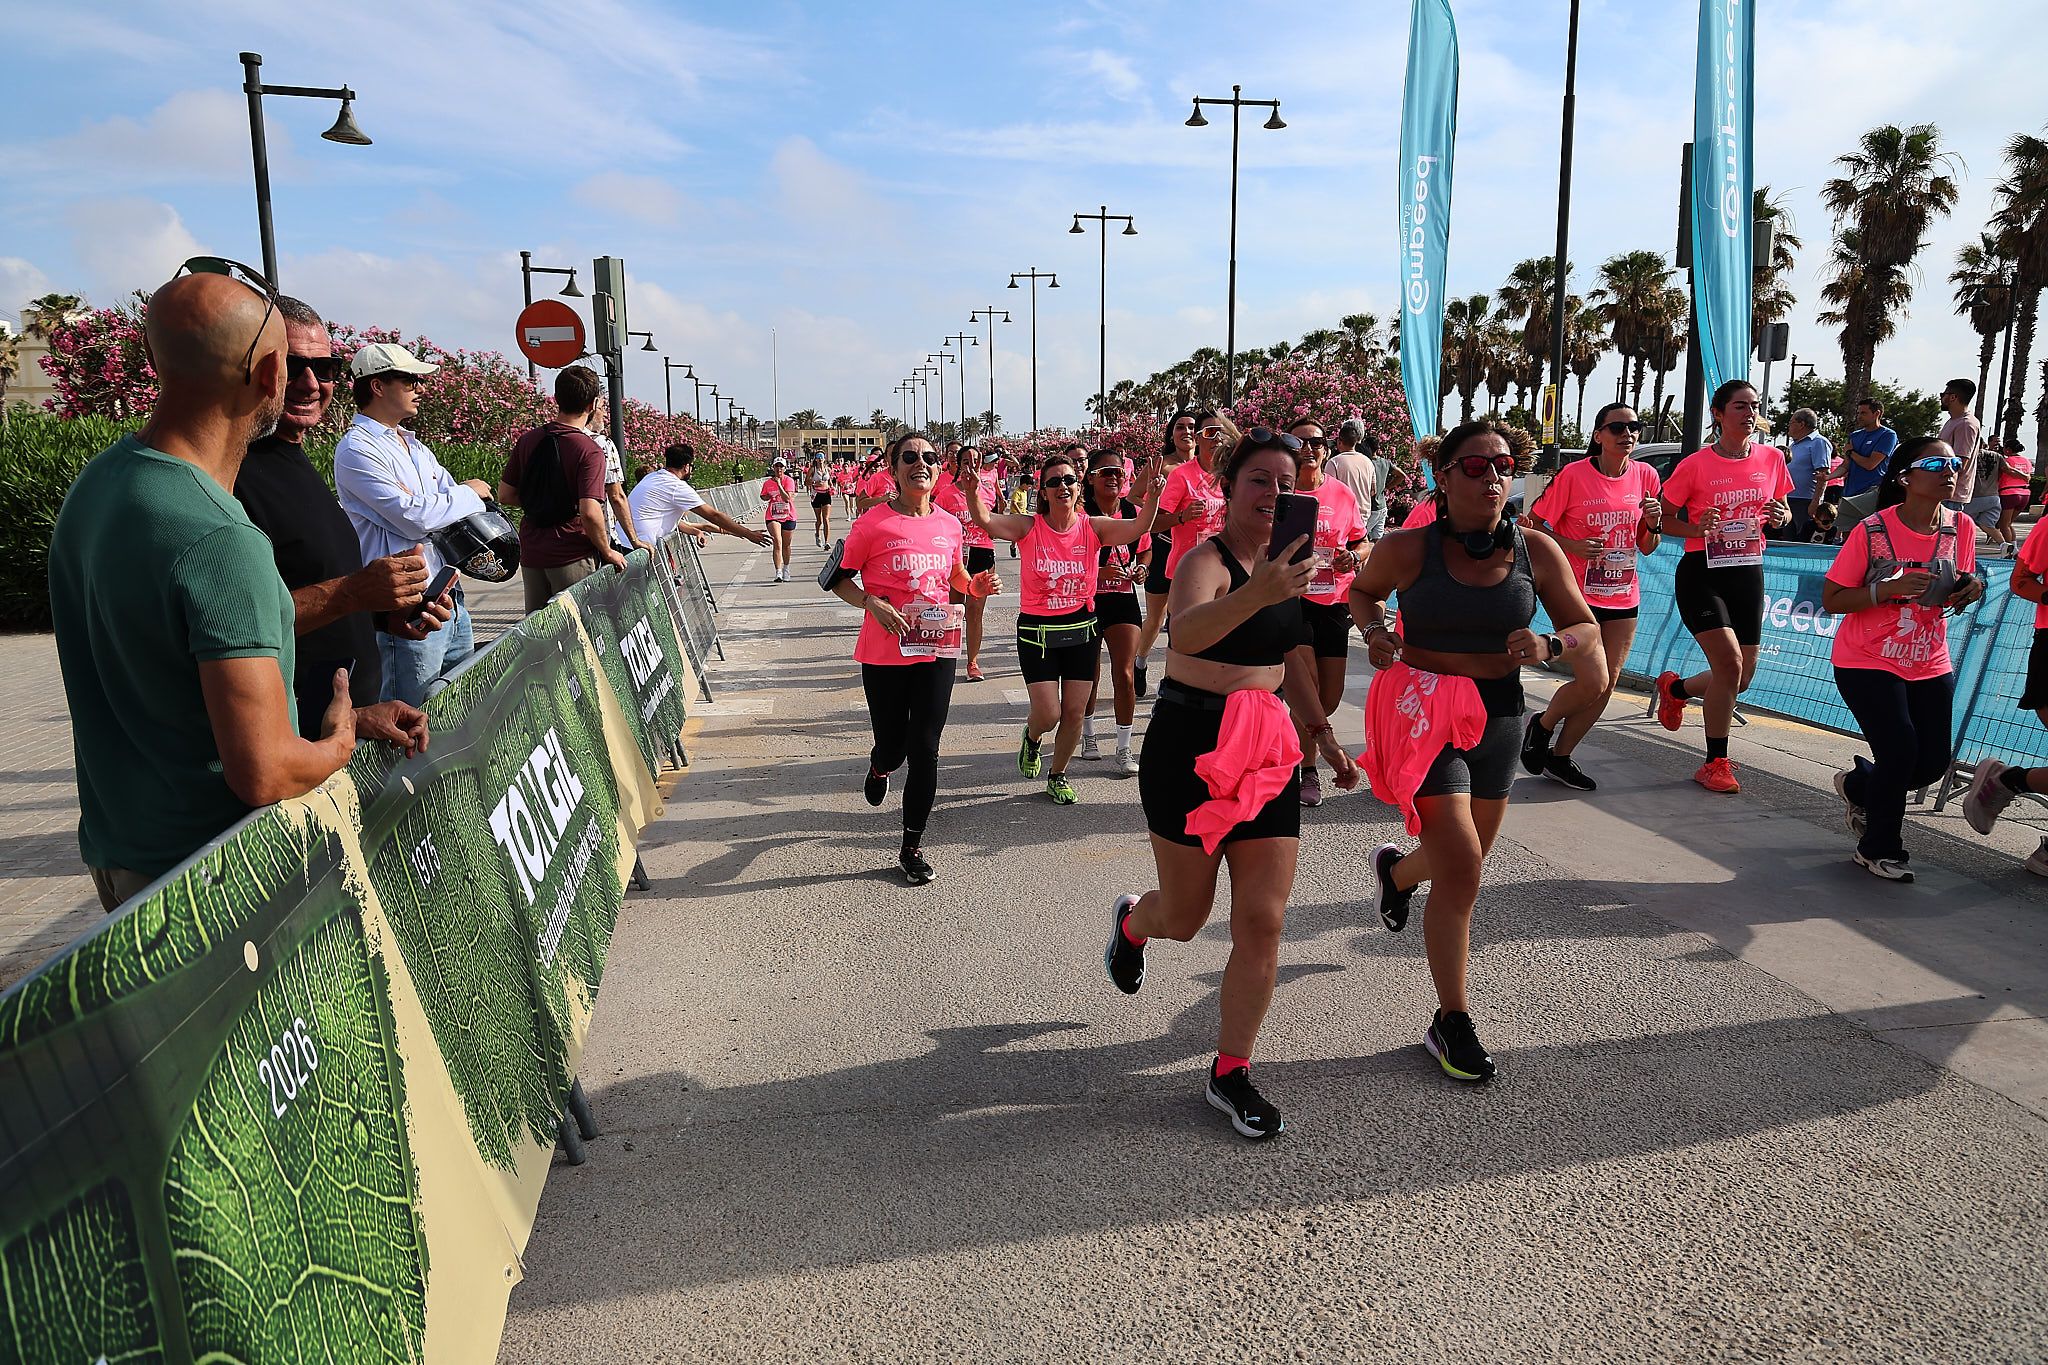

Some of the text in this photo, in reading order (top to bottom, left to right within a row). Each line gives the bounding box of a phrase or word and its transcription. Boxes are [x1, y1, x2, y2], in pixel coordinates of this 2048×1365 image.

[1714, 487, 1764, 506] CARRERA
[1587, 510, 1636, 526] CARRERA
[1725, 540, 1747, 549] 016
[892, 553, 947, 572] CARRERA
[1037, 559, 1085, 574] CARRERA
[1604, 570, 1623, 578] 016
[921, 630, 945, 638] 016
[1881, 641, 1931, 661] MUJER
[411, 832, 441, 889] 1975
[258, 1016, 319, 1120] 2026
